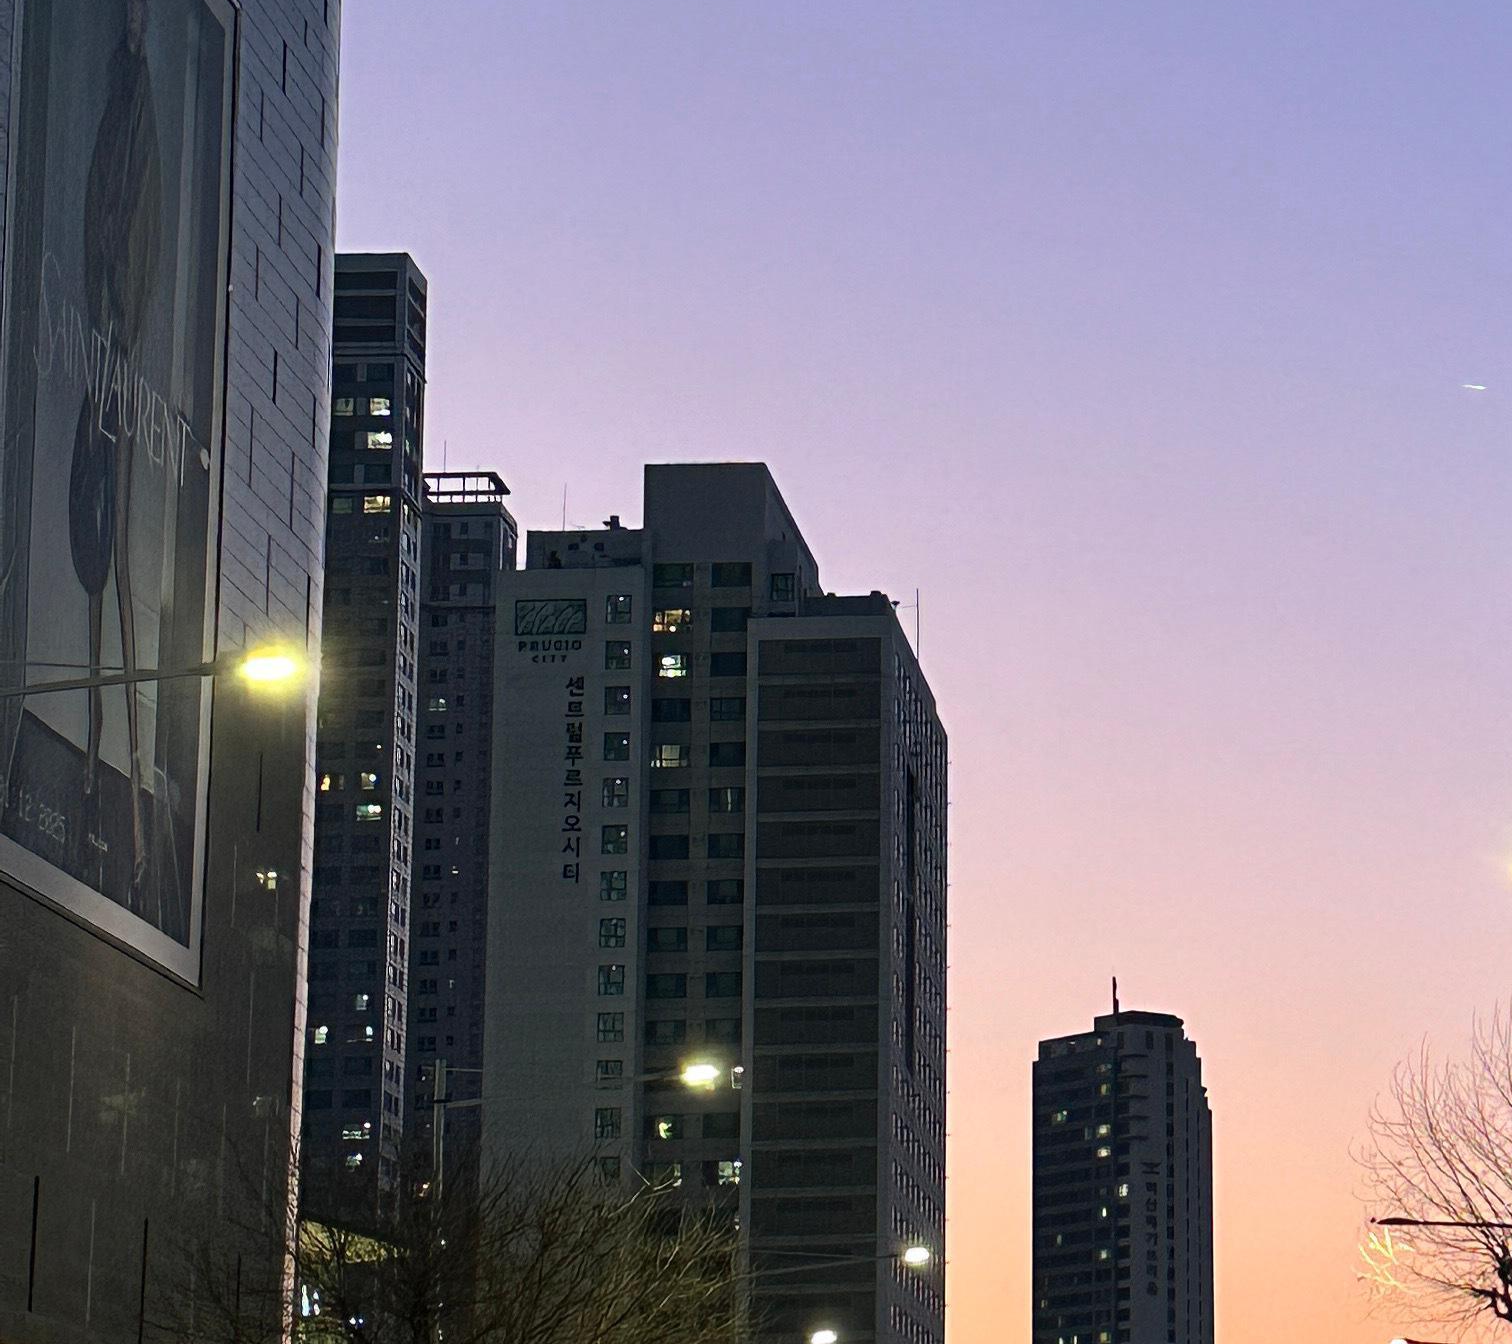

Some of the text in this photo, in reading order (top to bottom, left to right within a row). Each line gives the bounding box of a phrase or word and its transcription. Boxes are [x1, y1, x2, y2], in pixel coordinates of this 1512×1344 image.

[518, 640, 583, 653] PRUGIO
[531, 654, 568, 664] CITY
[562, 675, 585, 884] 센트럴푸르지오시티
